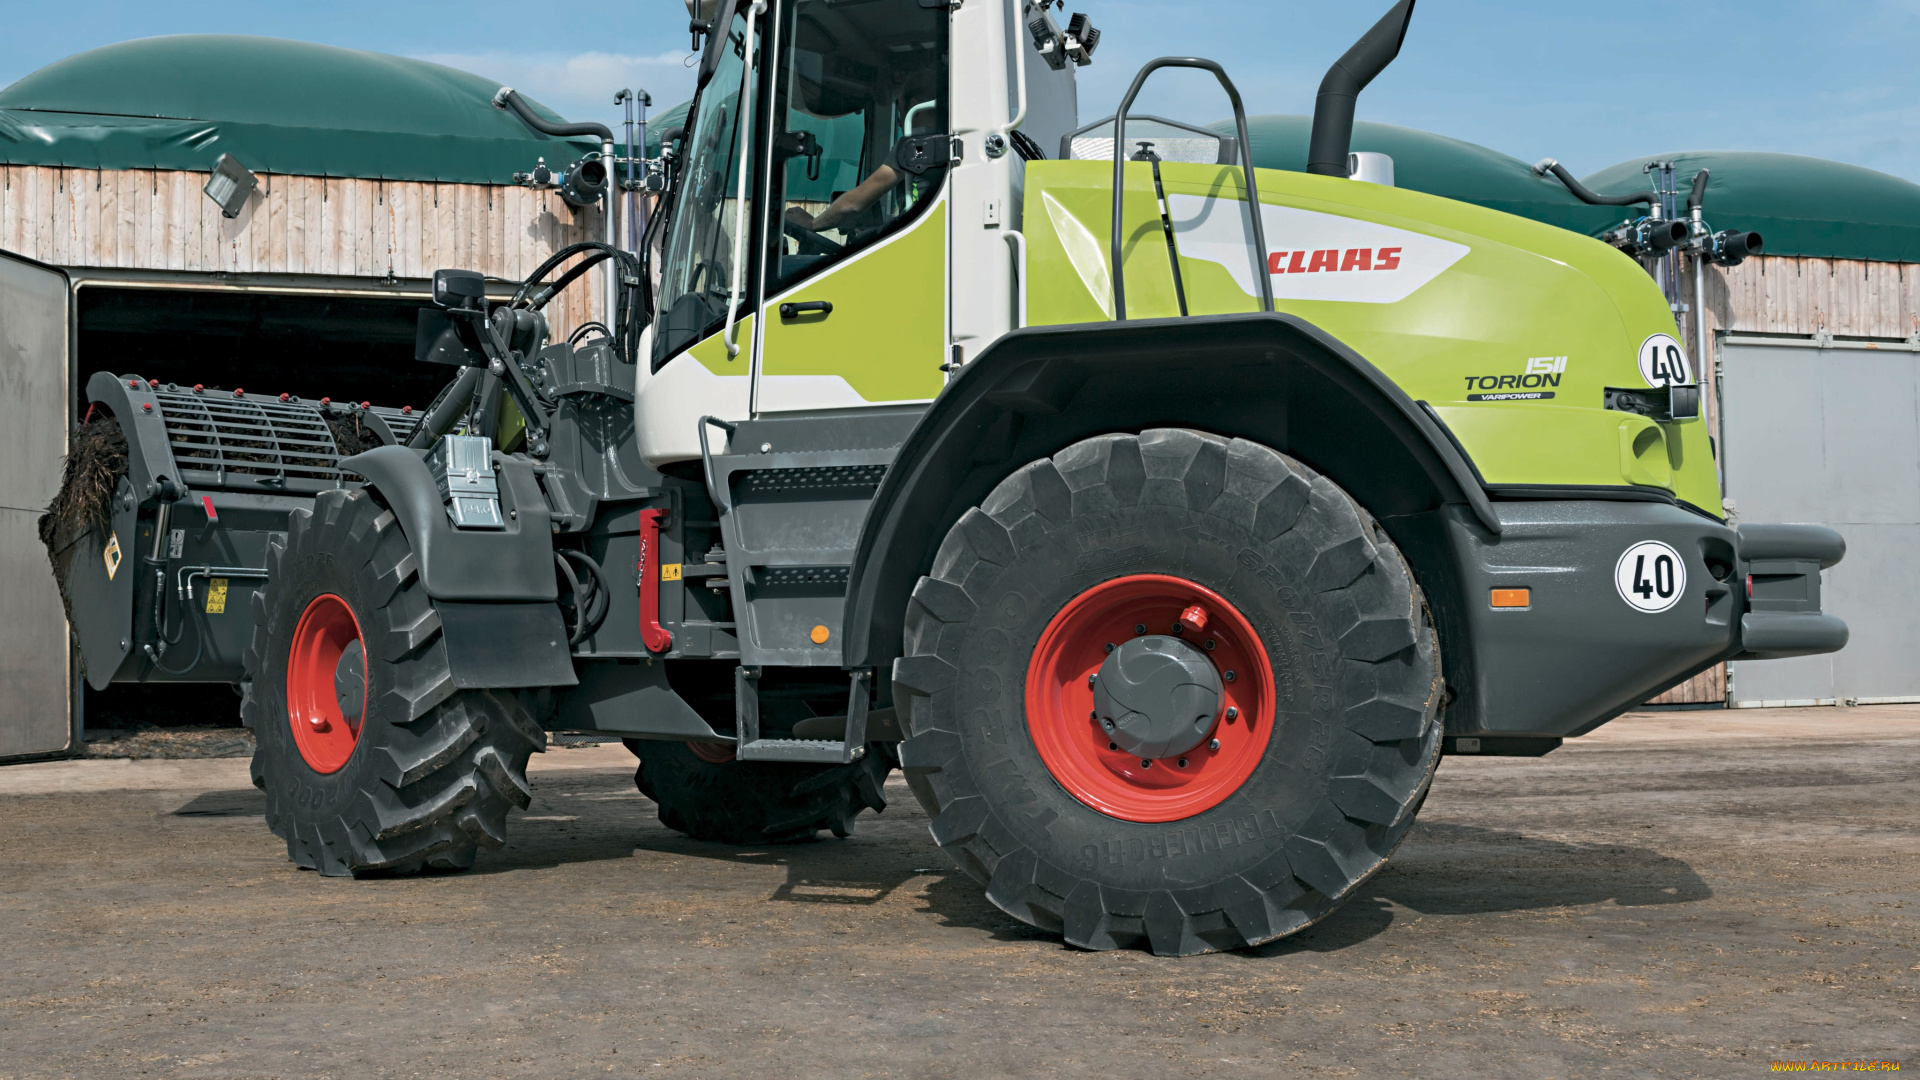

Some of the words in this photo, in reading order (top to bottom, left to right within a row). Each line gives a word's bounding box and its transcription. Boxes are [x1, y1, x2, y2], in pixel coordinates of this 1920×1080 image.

[1267, 247, 1402, 274] CLAAS
[1525, 356, 1568, 374] 1511
[1652, 344, 1686, 384] 40
[1464, 373, 1562, 390] TORION
[1481, 393, 1542, 401] VARIPOWER
[1633, 554, 1675, 600] 40
[1077, 808, 1288, 872] TRELLEBORG
